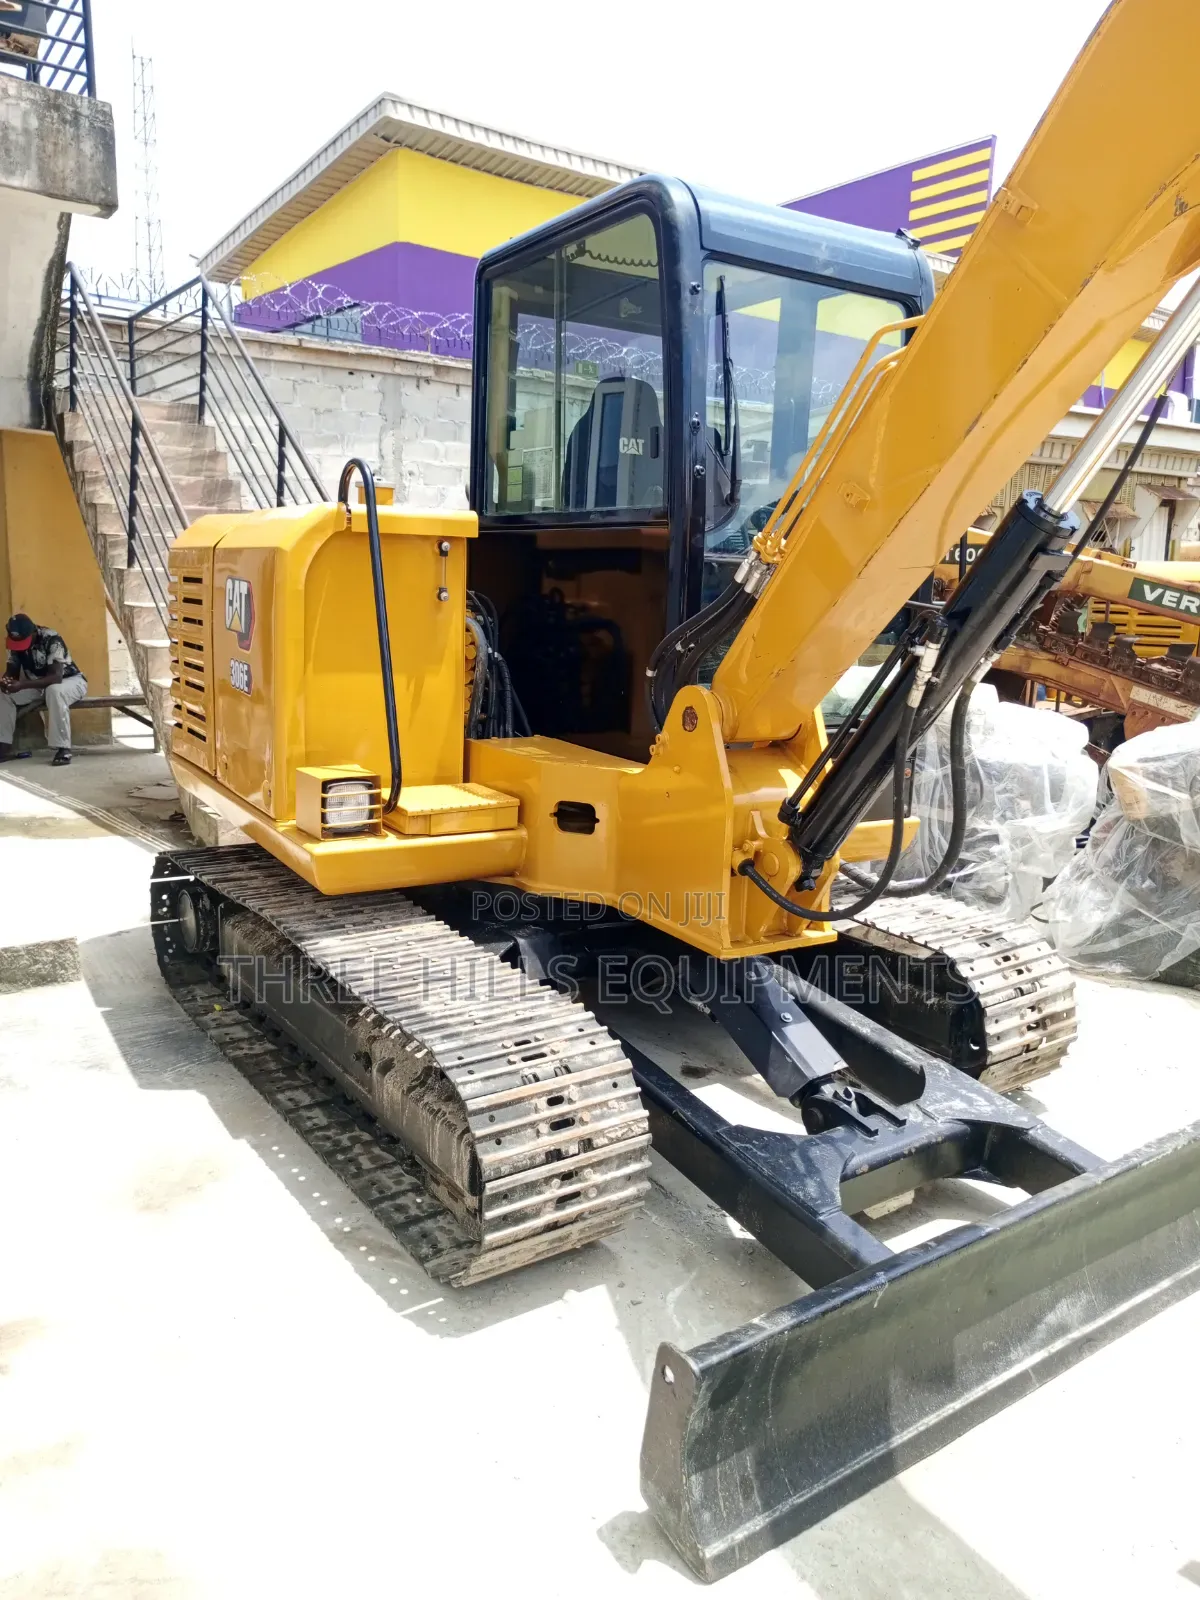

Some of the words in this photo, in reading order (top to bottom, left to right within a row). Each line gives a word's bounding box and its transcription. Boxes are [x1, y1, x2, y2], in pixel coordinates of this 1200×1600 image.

[619, 437, 645, 456] CAT
[226, 578, 248, 633] CAT
[1143, 584, 1200, 614] VER
[230, 659, 248, 692] 306E
